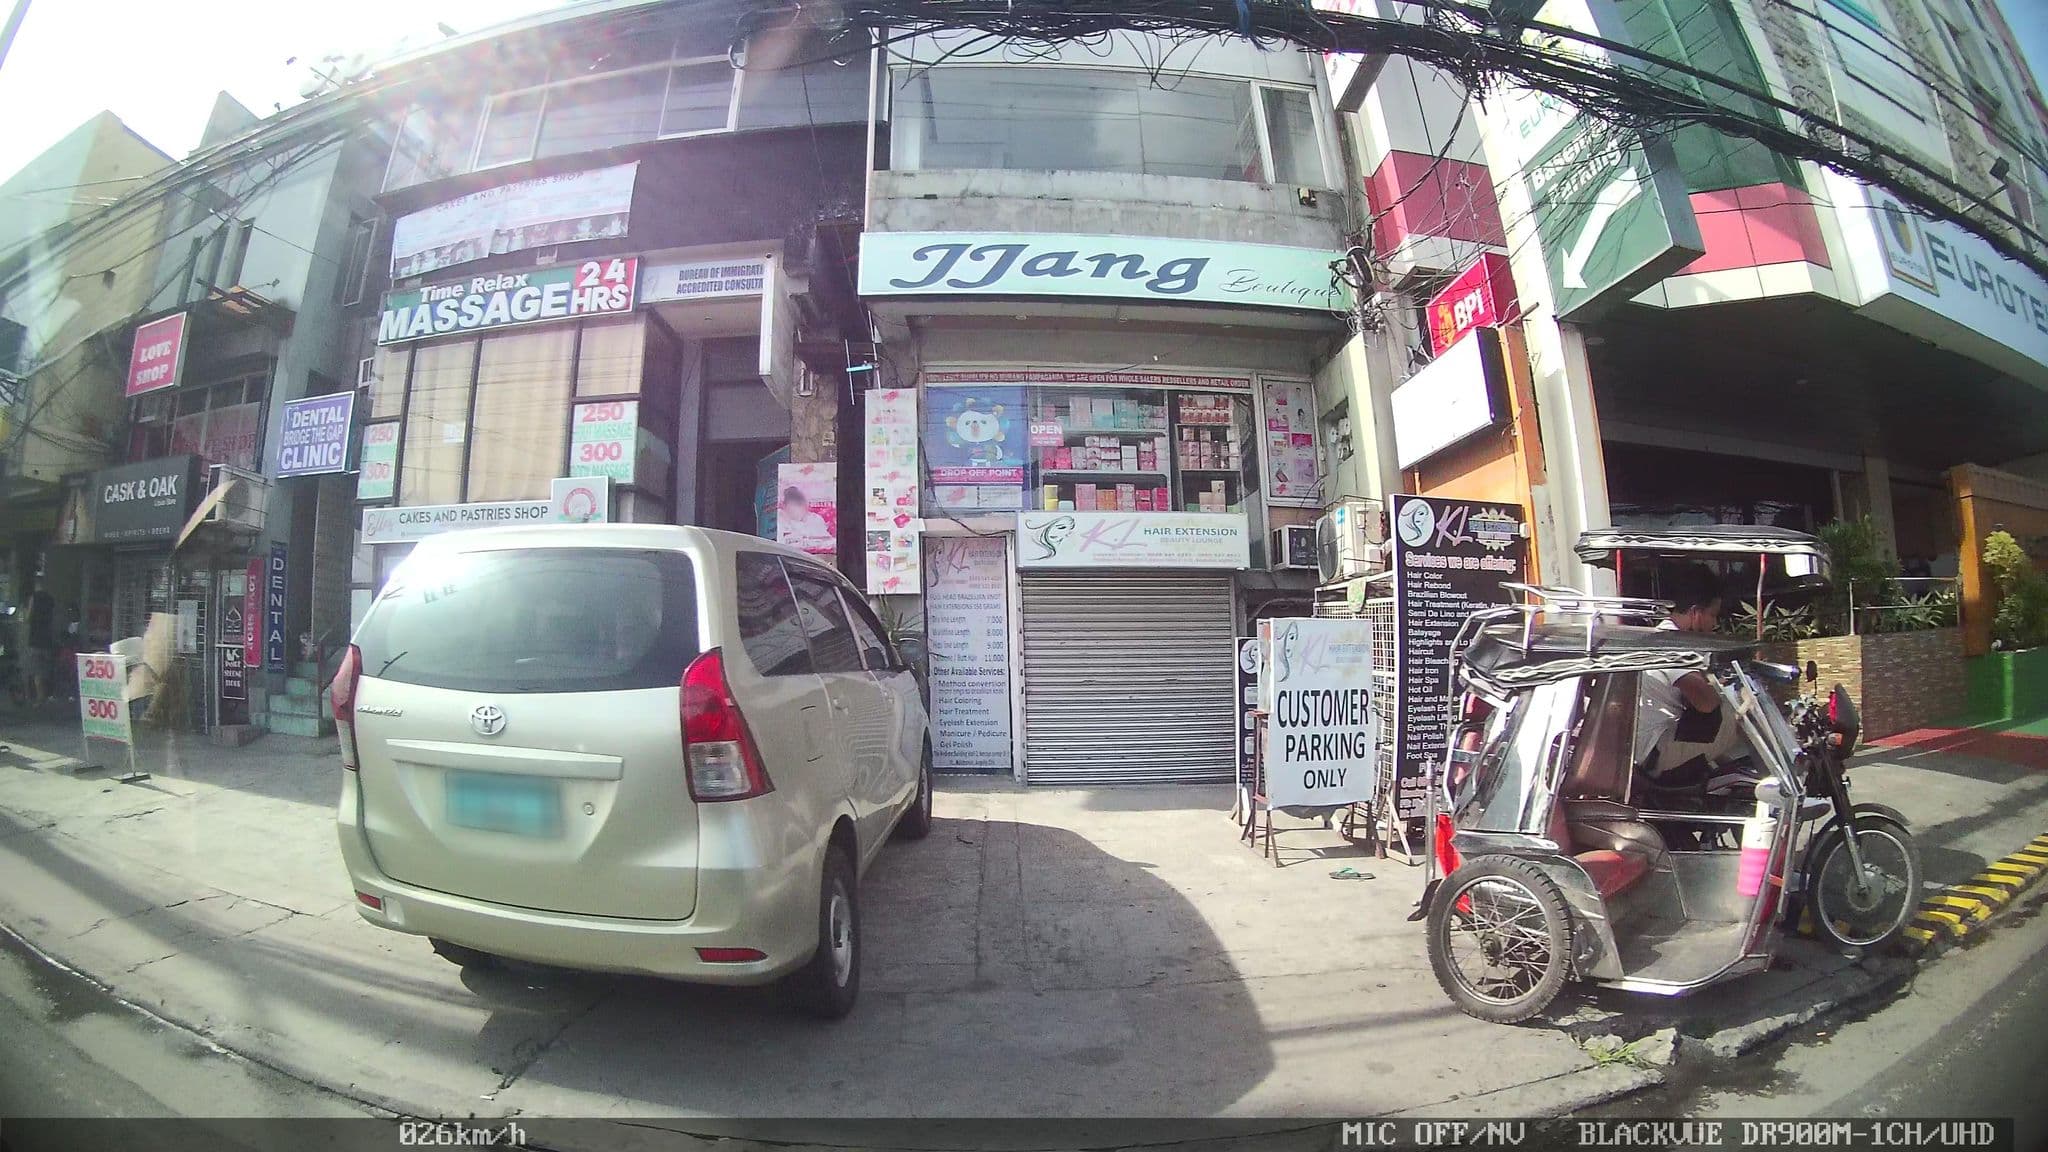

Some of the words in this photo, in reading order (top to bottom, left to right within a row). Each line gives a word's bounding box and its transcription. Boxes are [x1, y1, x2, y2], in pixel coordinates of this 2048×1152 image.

[578, 258, 627, 287] 24
[679, 268, 709, 281] BUREAU
[710, 267, 720, 279] OF
[888, 243, 1211, 295] JJang
[418, 282, 469, 304] Time
[470, 271, 529, 295] Relax
[676, 280, 723, 295] ACCREDITED
[1924, 230, 2048, 336] EUROTE
[379, 280, 571, 342] MASSAGE
[569, 284, 628, 316] HRS
[1453, 287, 1485, 331] BPI
[140, 340, 171, 363] LOVE
[135, 364, 169, 385] SHOP
[1089, 374, 1104, 382] OPEN
[1106, 374, 1118, 383] FOR
[1118, 375, 1139, 383] WHOLE
[1198, 377, 1210, 386] AND
[292, 406, 345, 429] DENTAL
[583, 403, 625, 423] 250
[283, 428, 311, 446] BRIDGE
[310, 426, 327, 444] THE
[326, 424, 343, 441] GAP
[1030, 425, 1063, 434] OPEN
[281, 443, 342, 470] CLINIC
[580, 442, 623, 462] 300
[941, 469, 966, 477] DROP
[968, 469, 988, 477] OFF
[989, 468, 1017, 477] POINT
[104, 481, 137, 504] CASK
[137, 480, 146, 499] &
[149, 474, 179, 498] OAK
[399, 511, 431, 525] CAKES
[434, 509, 458, 523] AND
[461, 507, 512, 522] PASTRIES
[515, 505, 549, 519] SHOP
[1144, 527, 1172, 536] HAIR
[1175, 527, 1239, 537] EXTENSION
[1405, 550, 1447, 569] Services
[1447, 556, 1463, 569] we
[1463, 557, 1480, 570] are
[1407, 571, 1423, 579] Hair
[1423, 571, 1444, 580] Color
[1407, 581, 1423, 589] Hair
[1423, 581, 1452, 590] Rebond
[1407, 590, 1439, 599] Brazilian
[1440, 591, 1468, 600] Blowout
[268, 557, 286, 661] DENTAL
[1424, 600, 1460, 609] Treatment
[1440, 610, 1456, 618] Lino
[1424, 619, 1460, 627] Extension
[1408, 628, 1442, 638] Balayage
[1408, 638, 1444, 648] Highlights
[1408, 648, 1435, 656] Haircut
[1408, 657, 1424, 665] Hair
[1424, 657, 1459, 666] Bleachg
[86, 658, 115, 680] 250
[933, 666, 950, 676] Other
[951, 666, 978, 676] Available
[1408, 676, 1424, 684] Hair
[1424, 676, 1440, 685] Spa
[1422, 685, 1433, 693] Oil
[954, 697, 982, 706] Coloring
[1408, 695, 1424, 703] Hair
[1424, 695, 1438, 703] and
[88, 698, 118, 721] 300
[1277, 688, 1369, 729] CUSTOMER
[1407, 704, 1437, 714] Eyelash
[939, 719, 964, 727] Eyelash
[1407, 714, 1436, 724] Eyelash
[1407, 723, 1438, 733] Eyebrow
[977, 730, 1007, 738] Pedicure
[1407, 733, 1422, 741] Nail
[1285, 731, 1366, 763] PARKING
[1406, 752, 1423, 760] Foot
[1423, 752, 1438, 760] Spa
[1303, 767, 1348, 790] ONLY
